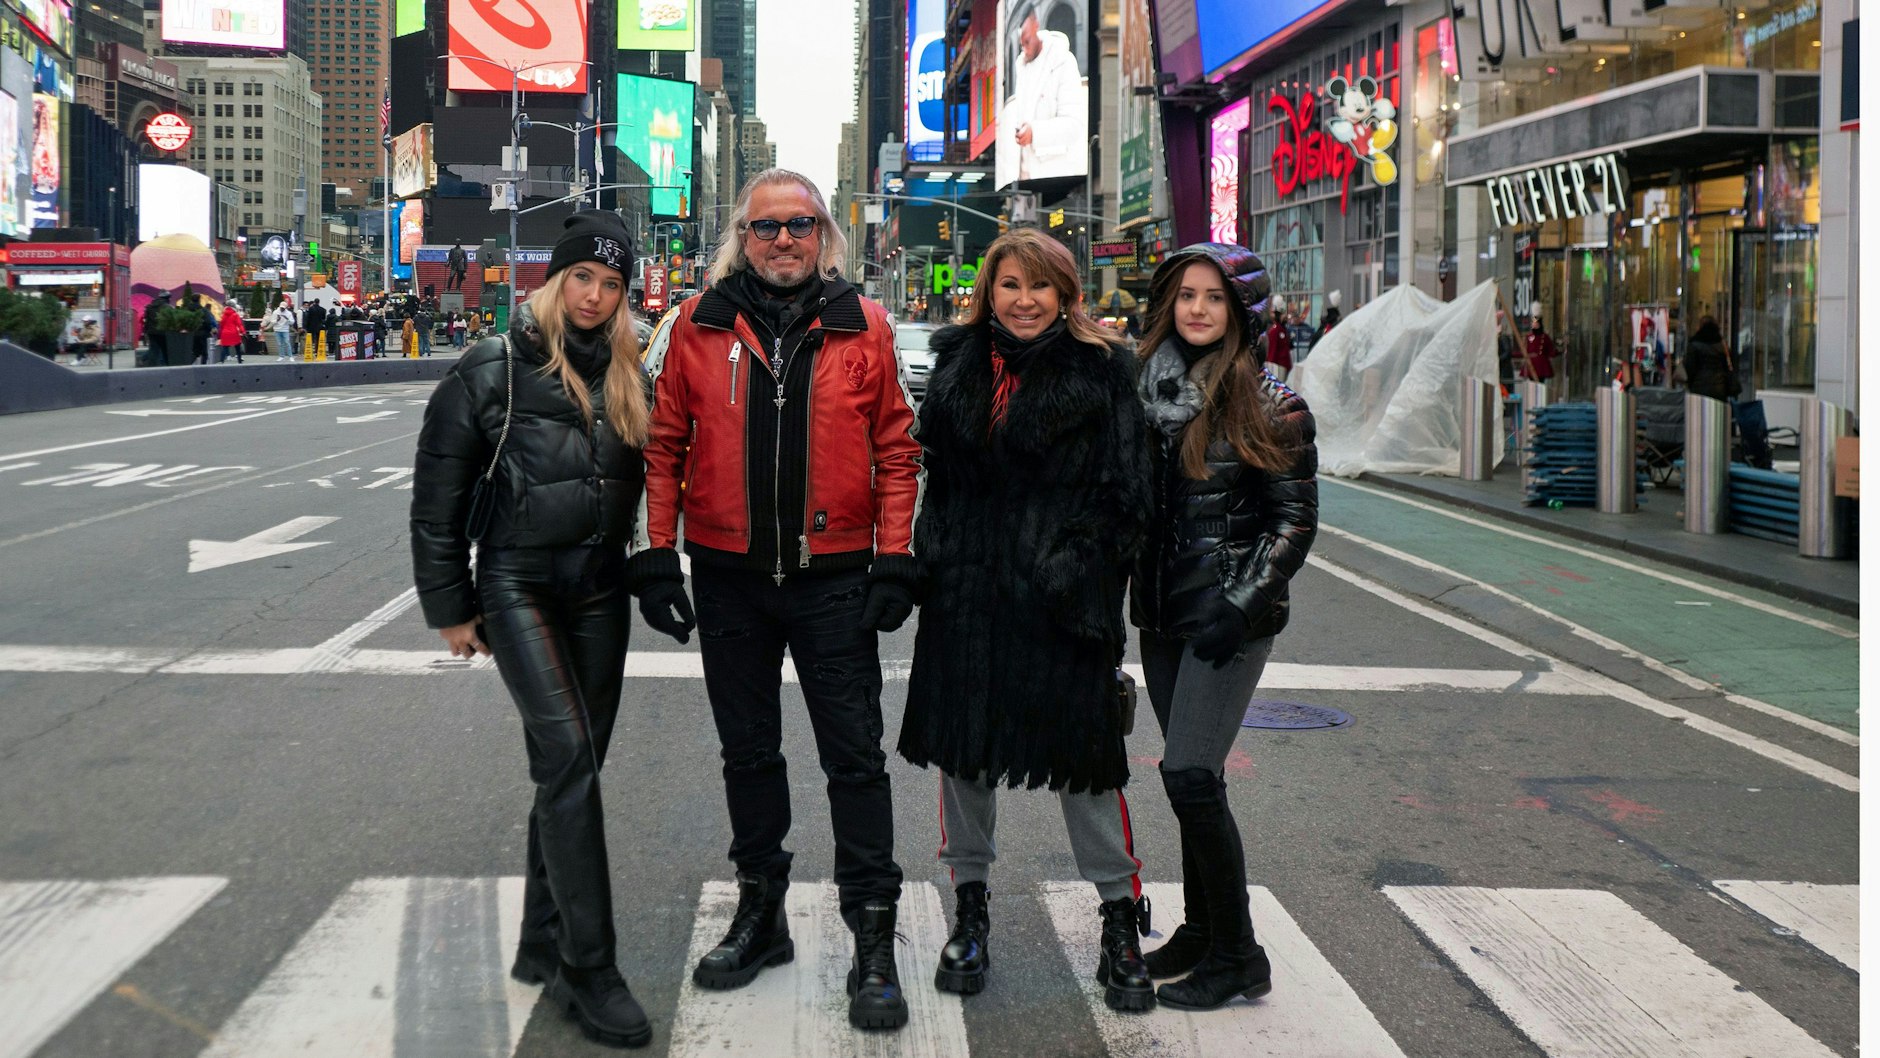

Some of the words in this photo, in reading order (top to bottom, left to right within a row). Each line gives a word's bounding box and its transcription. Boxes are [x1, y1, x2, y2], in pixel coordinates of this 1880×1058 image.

[1486, 161, 1592, 229] FOREVER
[1594, 153, 1626, 213] 21
[10, 250, 56, 258] COFFEED
[594, 236, 625, 269] NY
[343, 263, 358, 291] tkts
[650, 268, 664, 295] tkts
